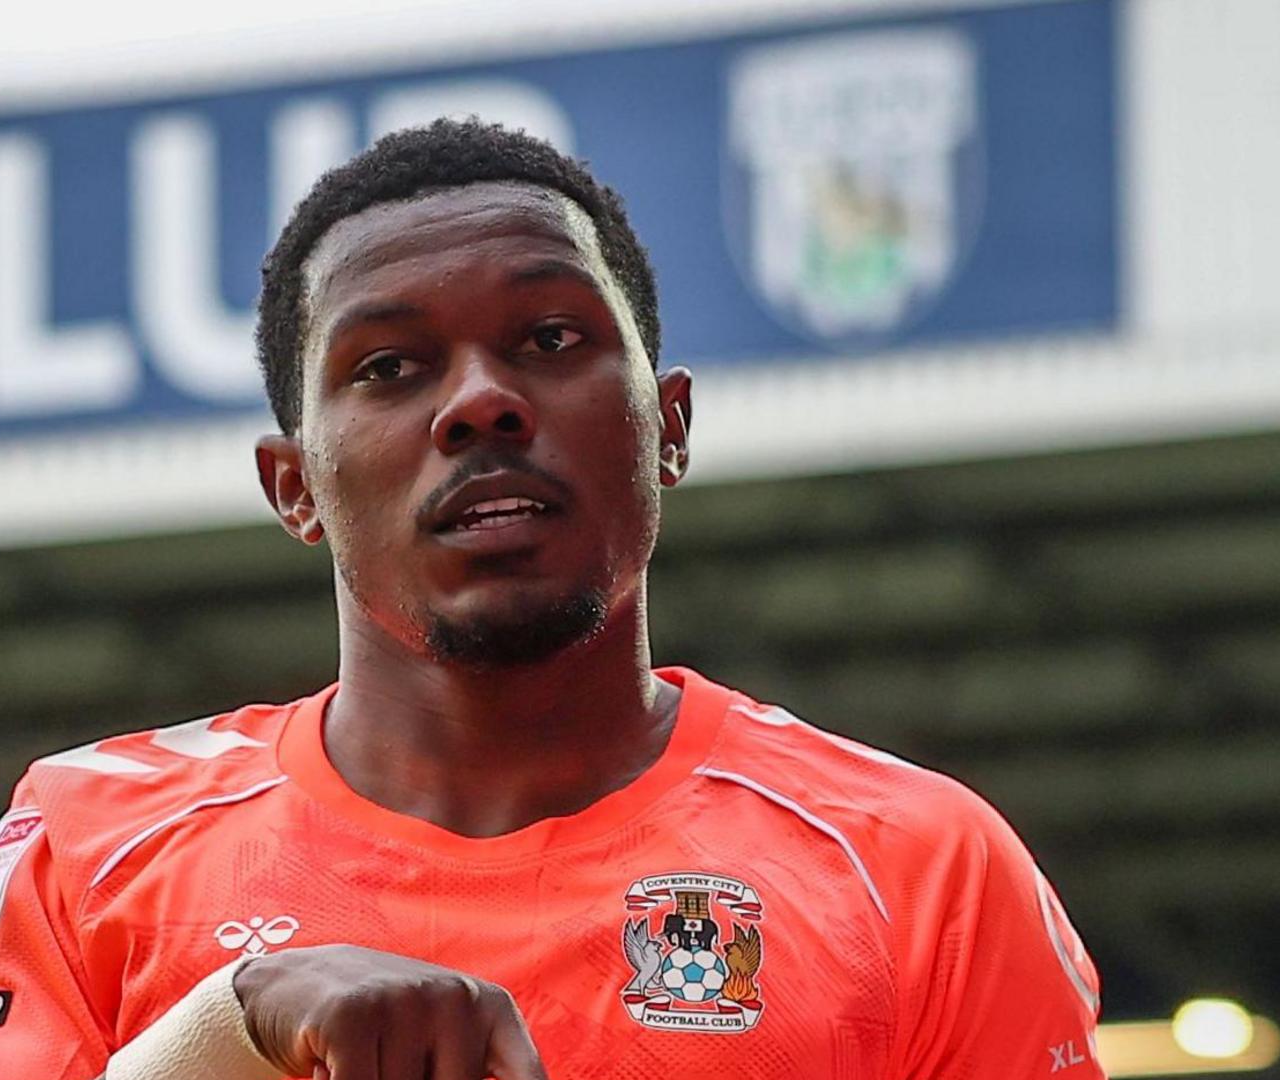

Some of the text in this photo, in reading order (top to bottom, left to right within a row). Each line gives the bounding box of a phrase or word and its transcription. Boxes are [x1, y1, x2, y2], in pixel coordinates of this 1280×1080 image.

[646, 877, 741, 892] COVENTRY CITY
[646, 1014, 742, 1028] FOOTBALL CLUB
[1049, 1041, 1084, 1073] XL
